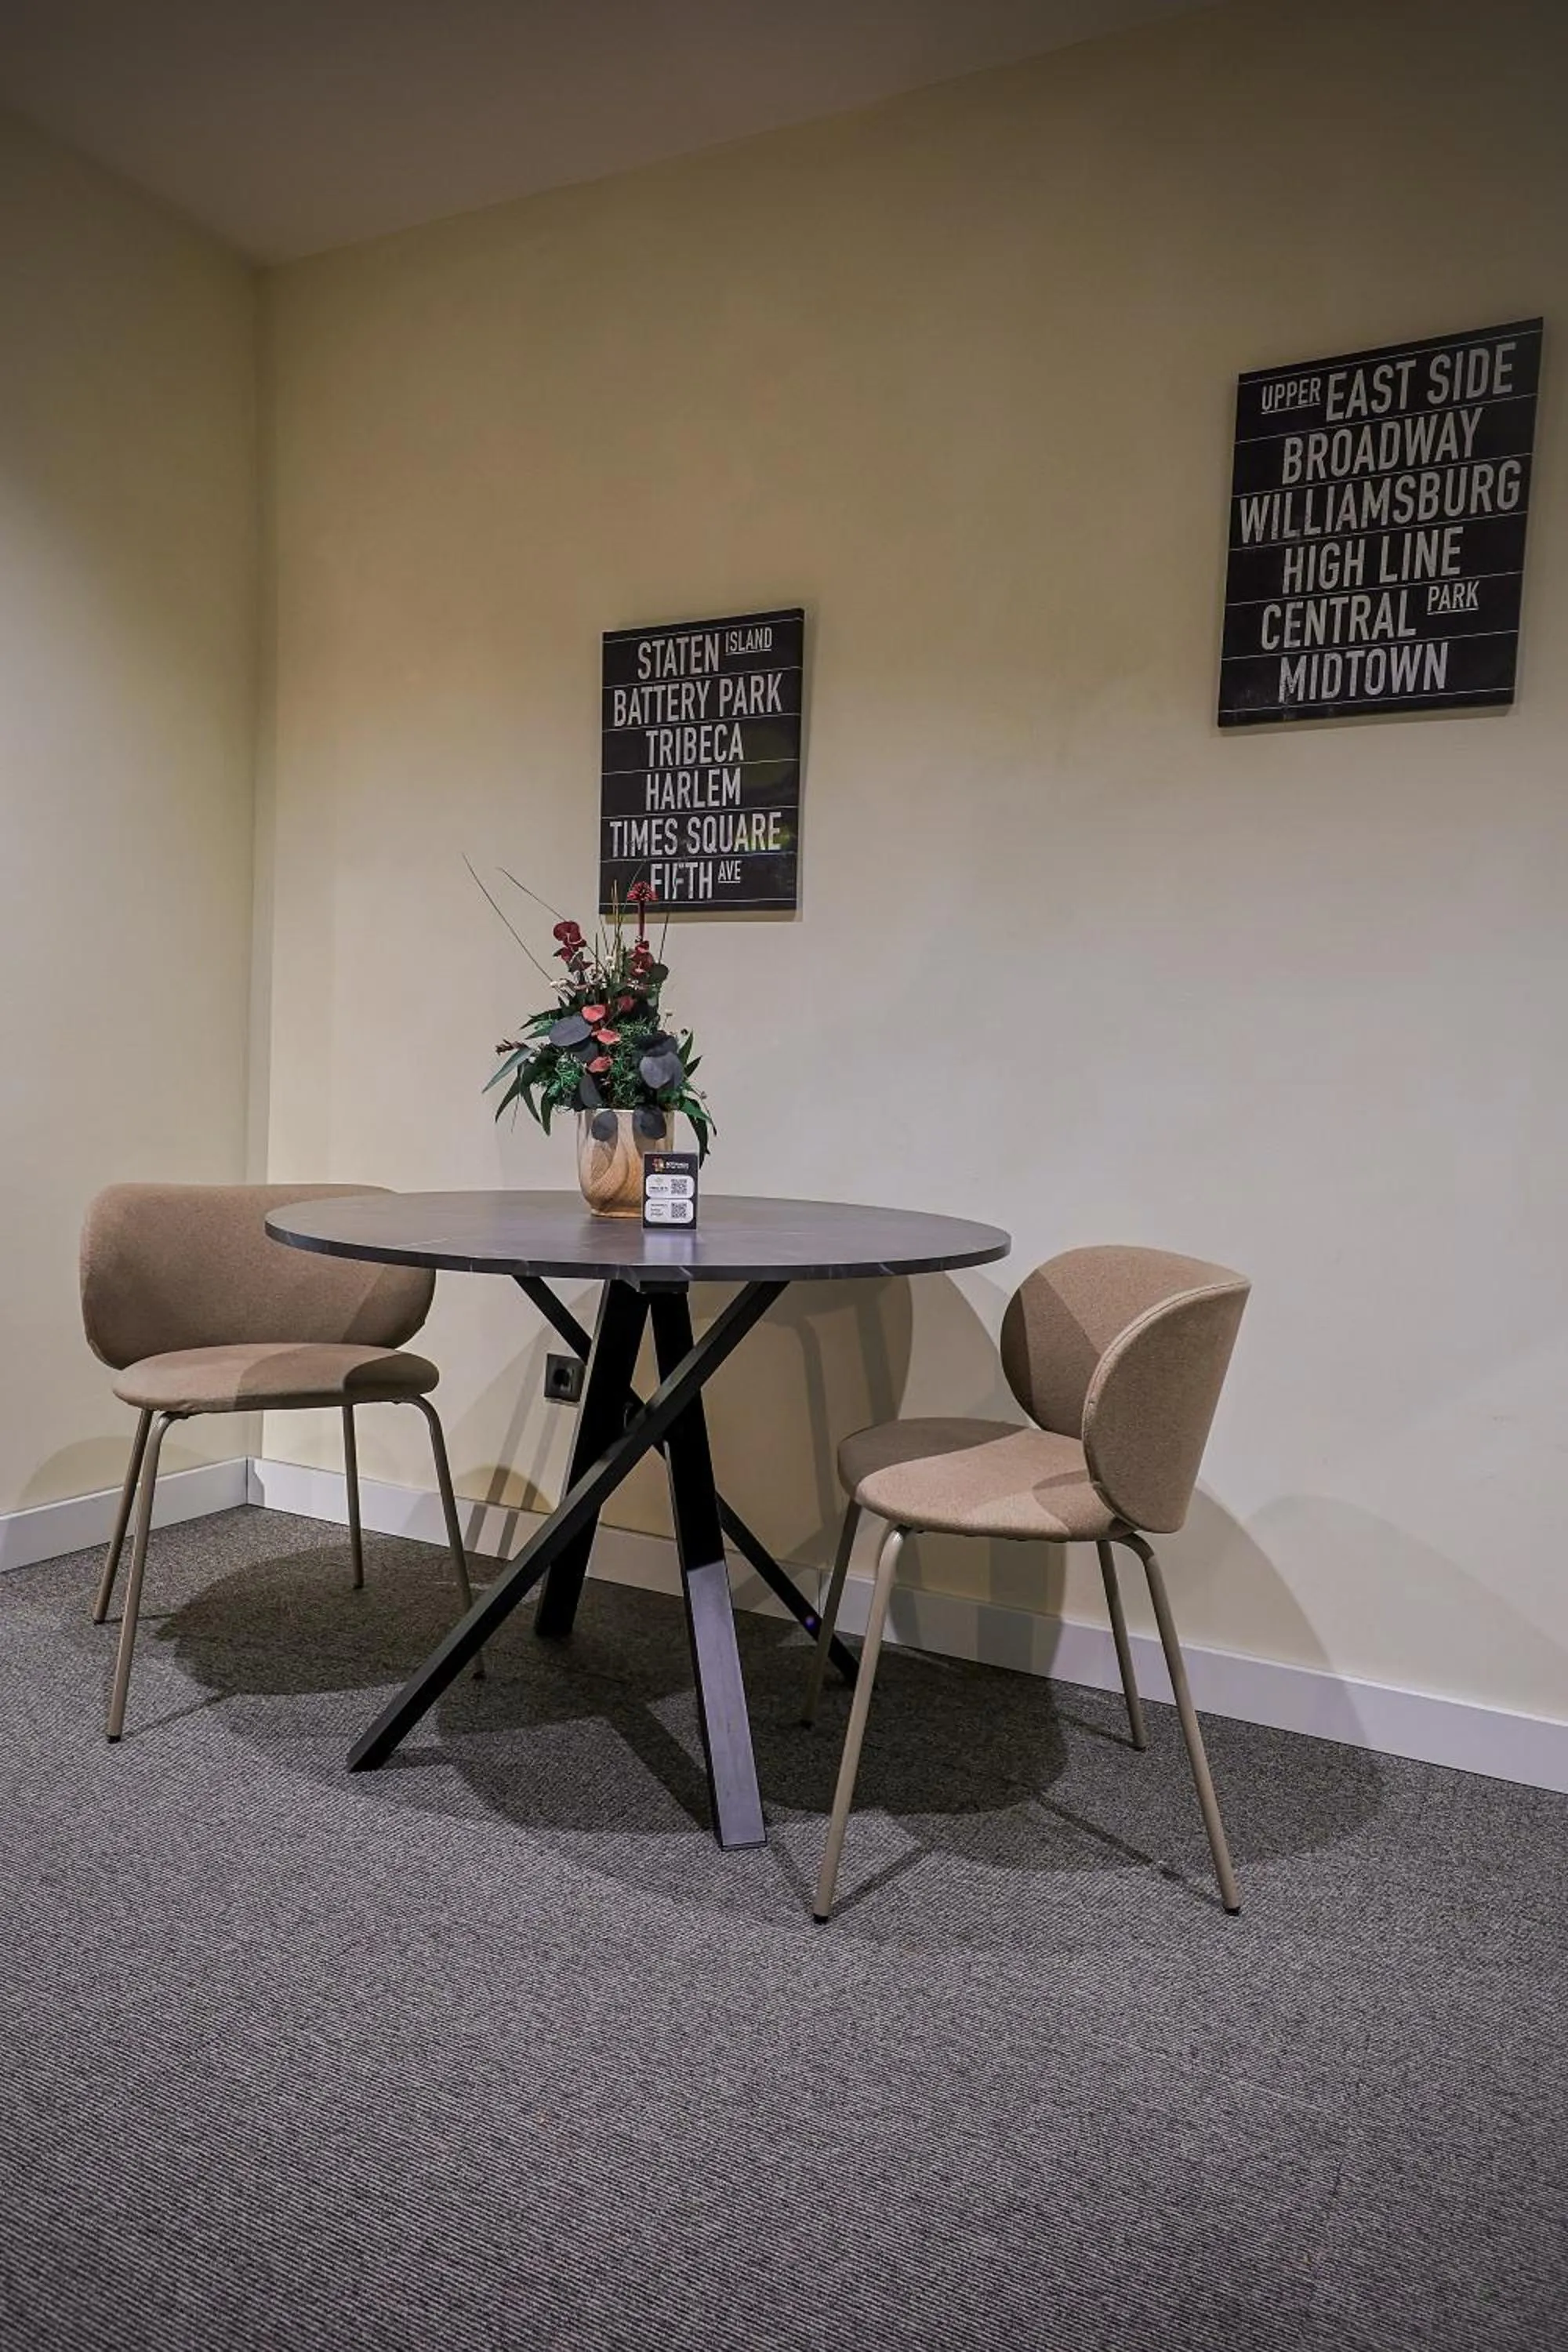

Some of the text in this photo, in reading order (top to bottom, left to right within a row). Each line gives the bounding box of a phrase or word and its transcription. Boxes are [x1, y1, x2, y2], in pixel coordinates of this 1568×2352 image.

[1261, 342, 1516, 422] UPPER EAST SIDE
[1283, 408, 1483, 484] BROADWAY
[1240, 460, 1522, 543] WILLIAMSBURG
[1282, 527, 1464, 593] HIGH LINE
[1261, 580, 1480, 650] CENTRAL PARK
[637, 627, 772, 680] STATEN ISLAND
[1278, 642, 1449, 703] MIDTOWN
[614, 672, 782, 727] BATTERY PARK
[645, 722, 744, 767] TRIBECA
[645, 768, 741, 811] HARLEM
[609, 811, 782, 858] TIMES SQUARE
[650, 860, 741, 900] FIFTH AVE
